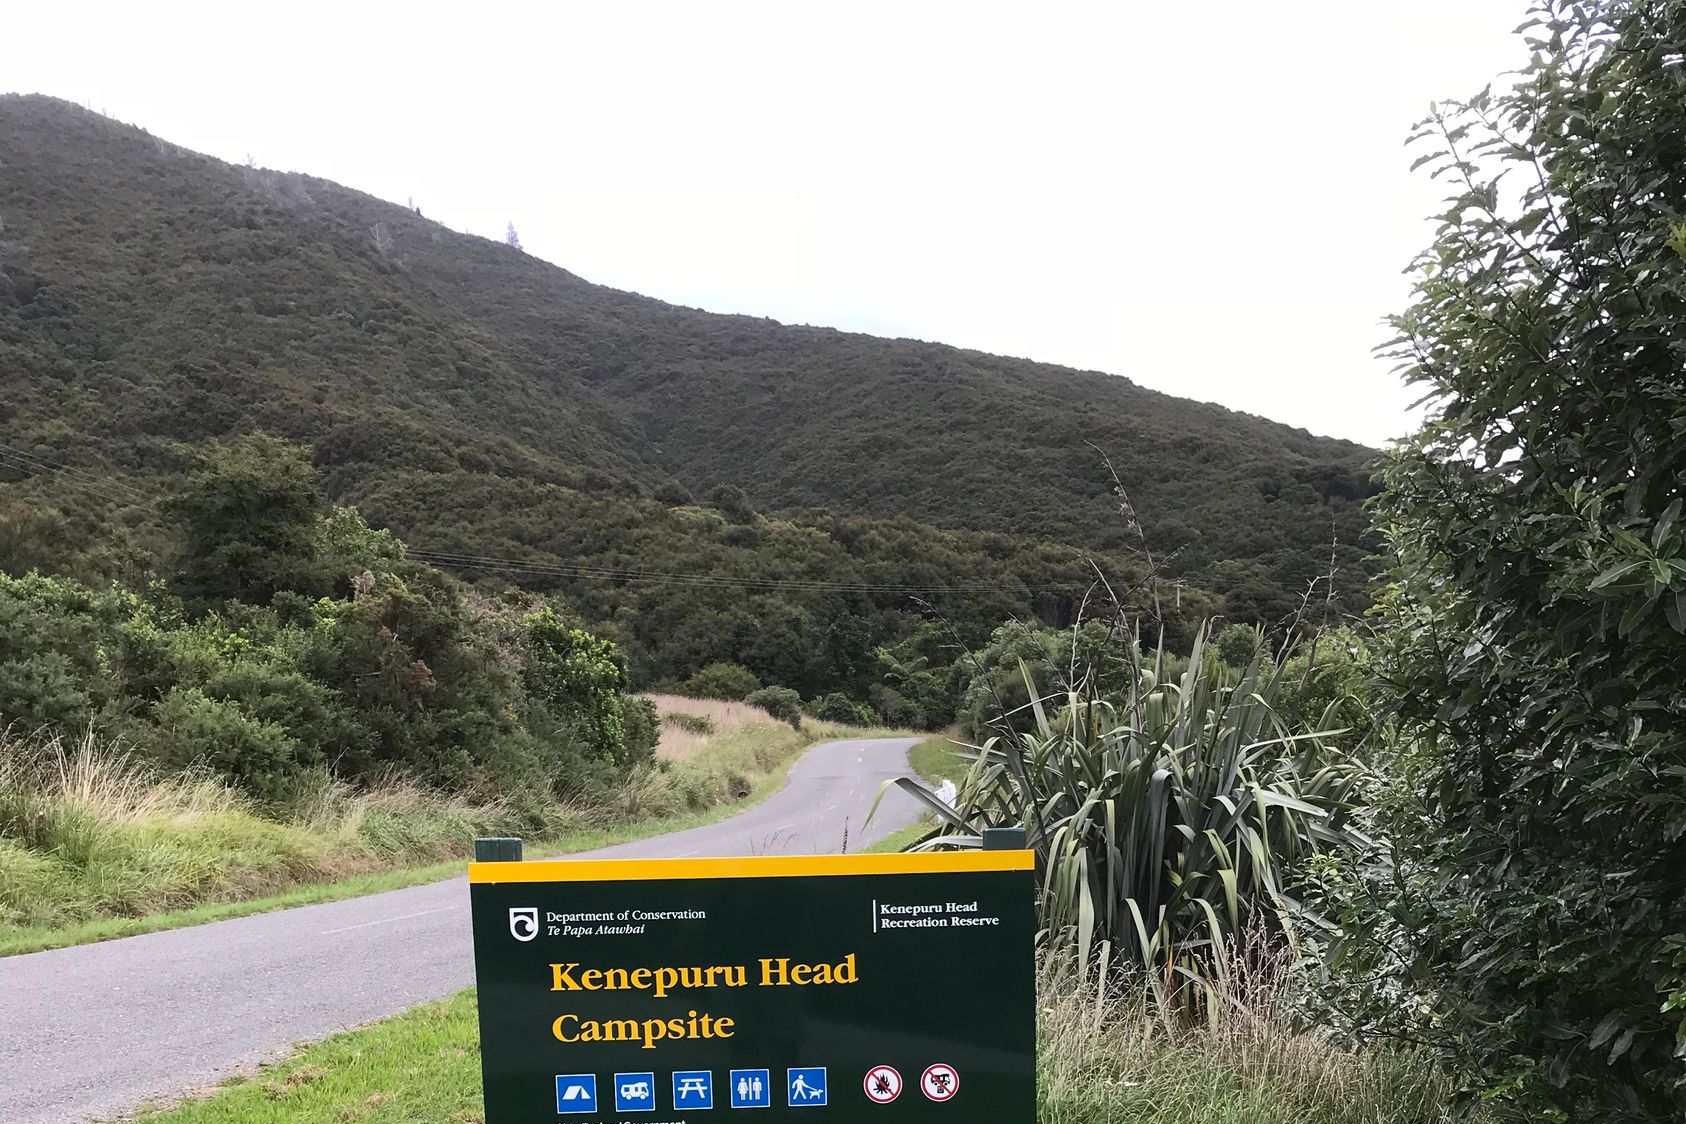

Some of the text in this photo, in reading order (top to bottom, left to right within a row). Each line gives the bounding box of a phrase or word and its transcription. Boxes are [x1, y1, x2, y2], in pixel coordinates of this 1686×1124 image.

[546, 908, 707, 925] Department of Conservation
[880, 900, 978, 917] Kenepuru Head
[547, 923, 646, 938] Te Papa Atawhai
[880, 915, 1000, 929] Recreation Reserve
[548, 952, 859, 998] Kenepuru Head
[551, 1009, 736, 1049] Campsite
